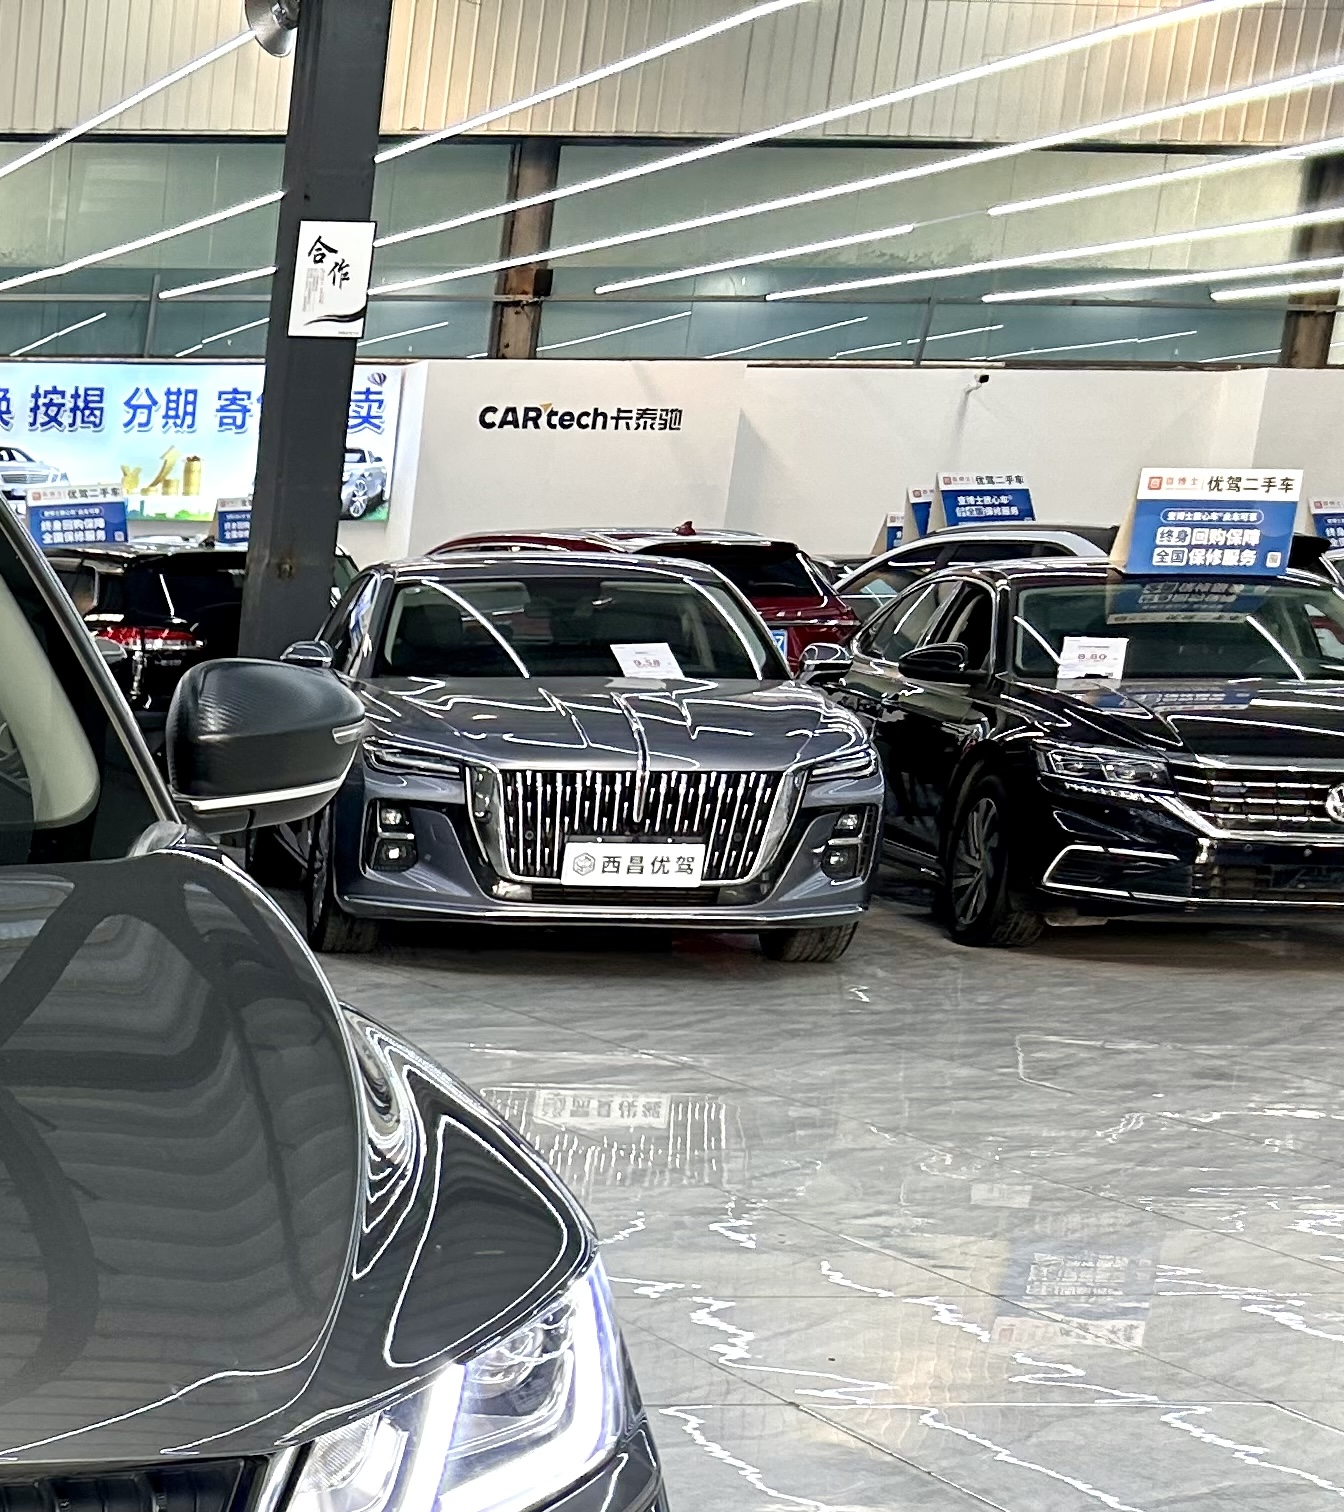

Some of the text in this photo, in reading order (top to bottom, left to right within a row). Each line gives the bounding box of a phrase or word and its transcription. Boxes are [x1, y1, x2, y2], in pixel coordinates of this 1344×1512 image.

[308, 235, 350, 290] 合作
[29, 385, 105, 431] 按揭
[123, 387, 197, 432] 分期
[215, 387, 264, 434] 寄
[1207, 475, 1295, 493] 优驾二手车
[601, 855, 696, 875] 西昌优驾
